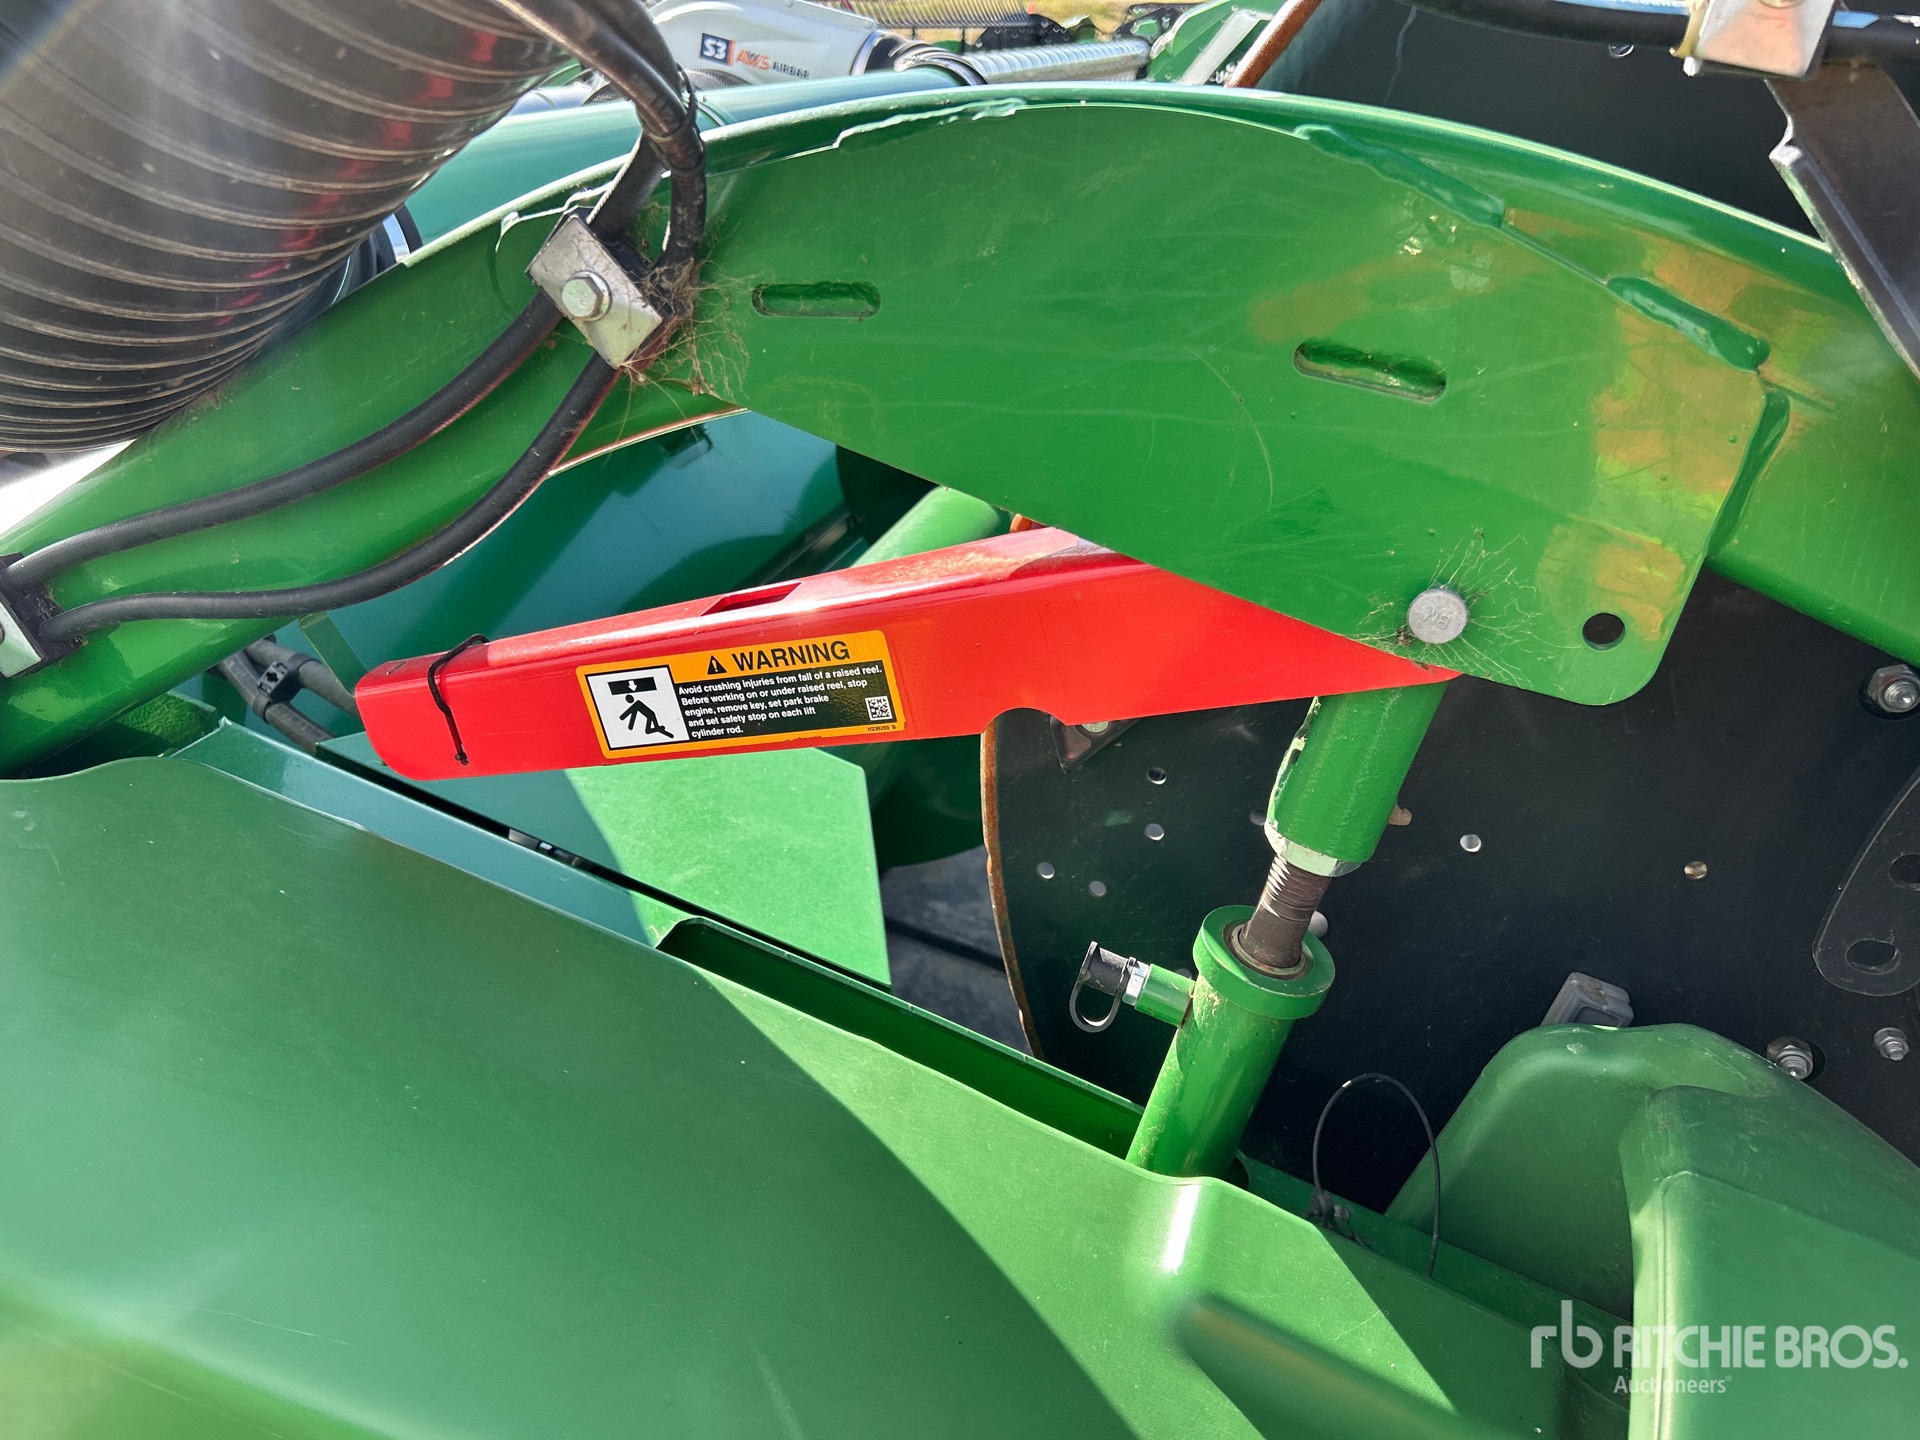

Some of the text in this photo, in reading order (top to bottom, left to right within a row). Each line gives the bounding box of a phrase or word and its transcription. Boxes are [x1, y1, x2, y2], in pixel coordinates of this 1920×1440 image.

[703, 38, 727, 60] S3
[731, 640, 850, 671] WARNING
[679, 685, 702, 695] Avoid
[704, 681, 741, 693] crushing
[742, 678, 775, 689] injuries
[776, 674, 797, 684] from
[798, 672, 813, 682] fall
[814, 671, 824, 680] of
[833, 667, 860, 678] raised
[862, 664, 882, 674] reel.
[681, 679, 868, 706] Before working on or under raised reel, stop
[685, 694, 829, 718] engine, remove key, set park brake
[688, 706, 816, 727] and set safety stop on each lift
[691, 725, 744, 738] cylinder rod.
